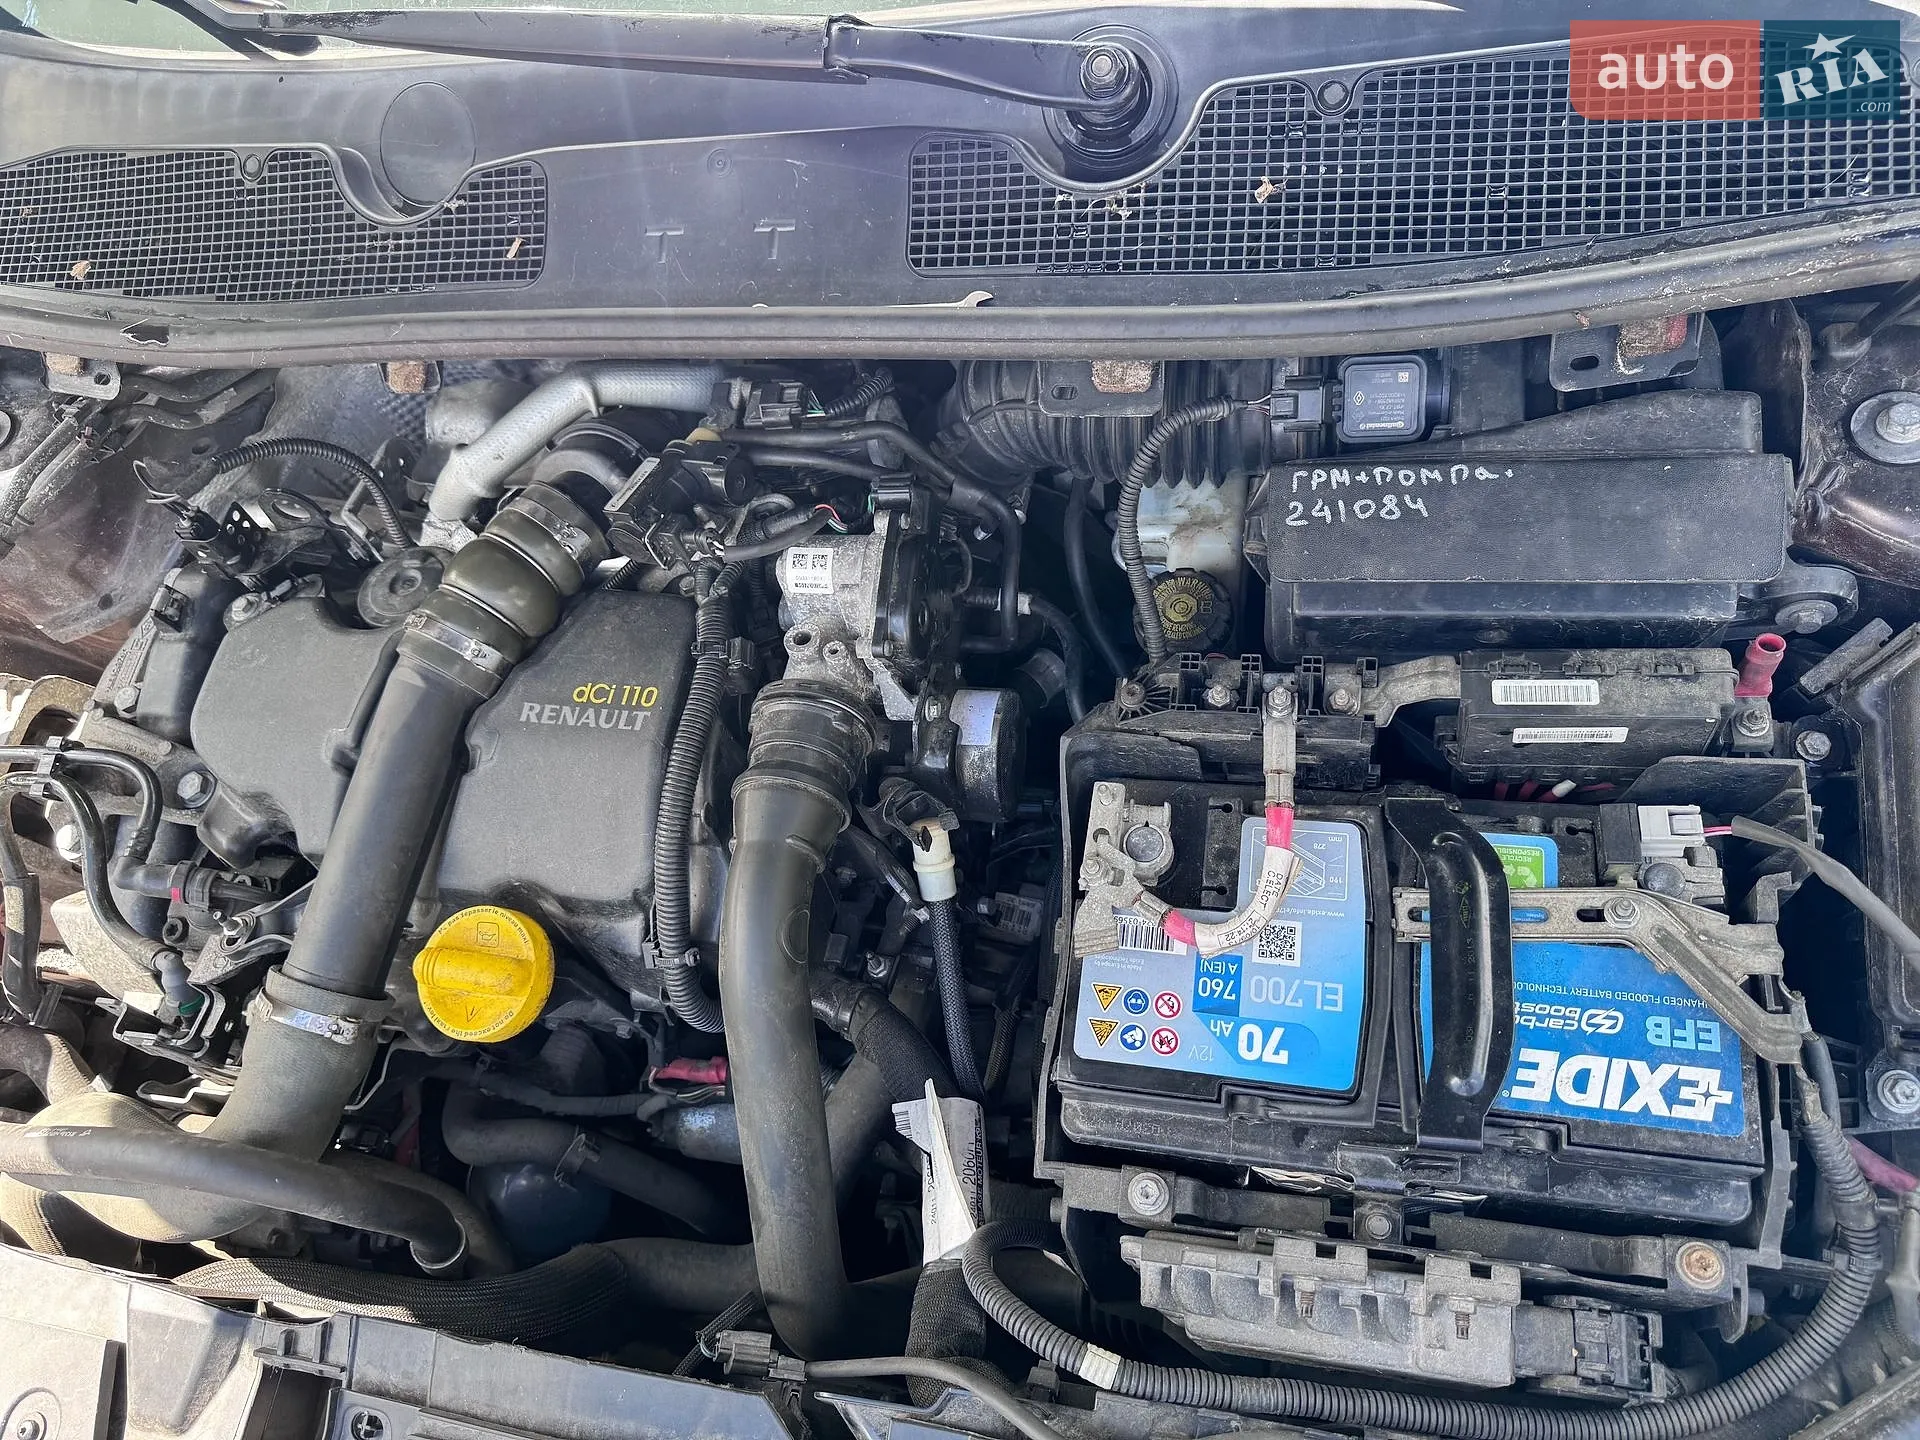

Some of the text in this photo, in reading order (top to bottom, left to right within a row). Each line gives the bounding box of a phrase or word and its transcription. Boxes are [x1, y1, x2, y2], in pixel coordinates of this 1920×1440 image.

[1285, 494, 1429, 526] 241084
[572, 683, 658, 708] dCi 110
[519, 702, 652, 731] RENAULT
[1496, 847, 1540, 856] RESPONSIBL
[1271, 873, 1284, 897] DATE
[1228, 962, 1239, 974] A
[1197, 977, 1236, 1000] 760
[1250, 976, 1344, 1012] EL700
[1569, 986, 1613, 1000] BATTERY
[1614, 991, 1661, 1004] FLOODED
[1663, 996, 1709, 1009] HANCED
[1210, 1019, 1289, 1065] 70 Ah
[1646, 1015, 1721, 1053] EFB
[1188, 1044, 1214, 1062] 12V
[1512, 1048, 1733, 1121] EXIDE
